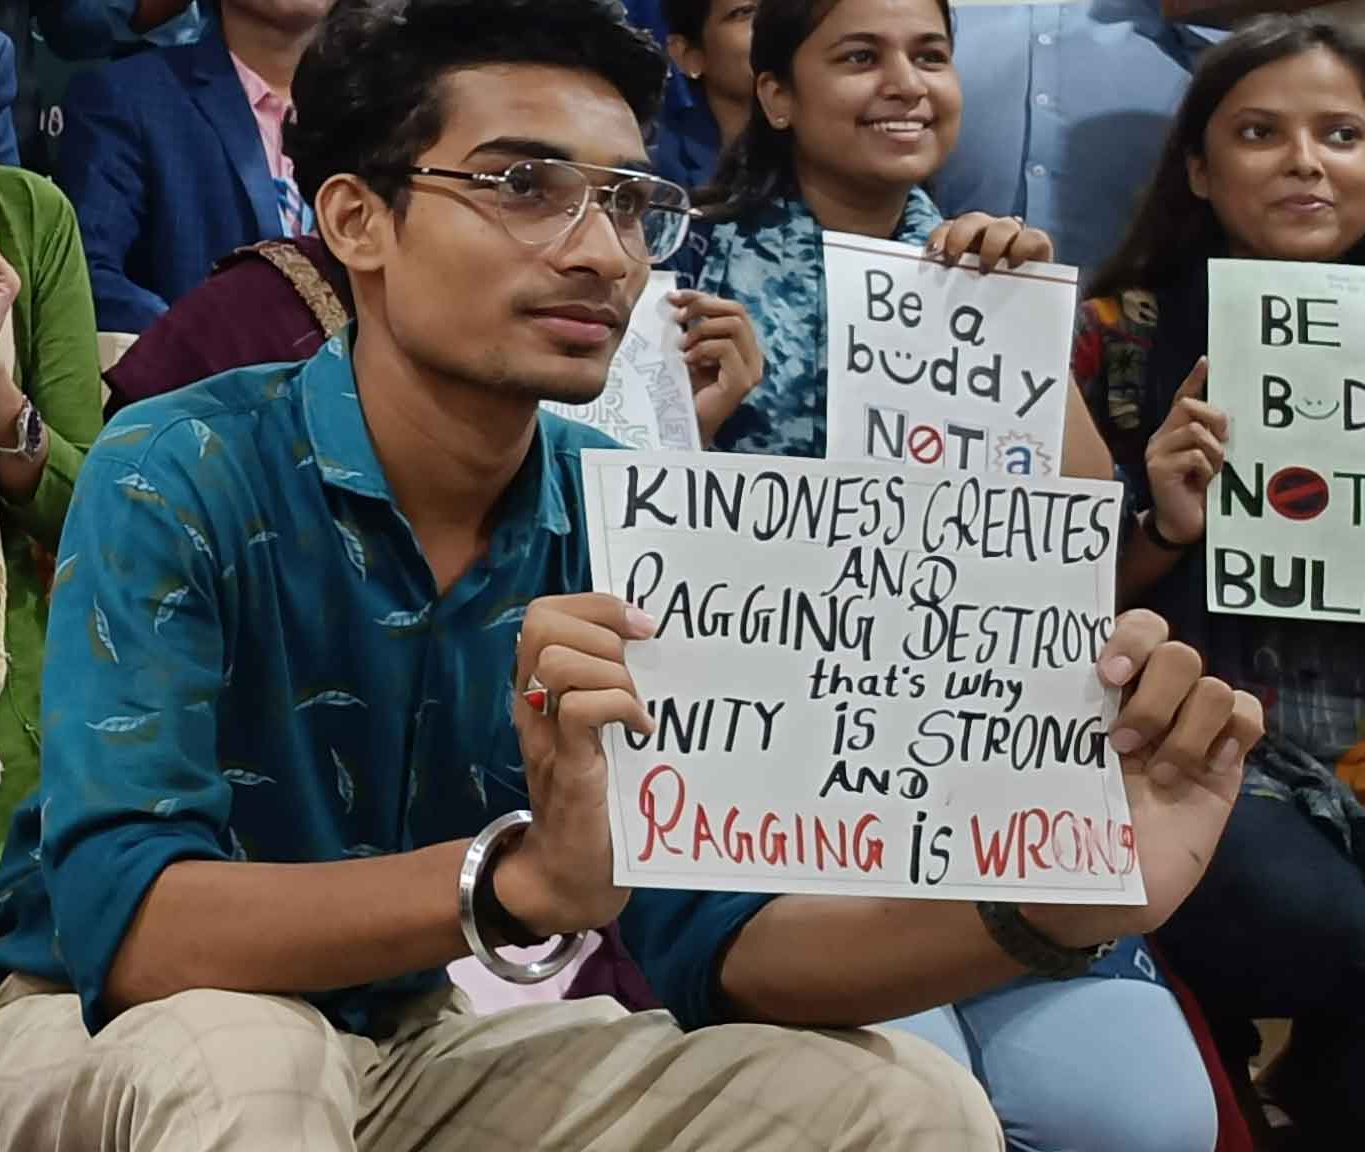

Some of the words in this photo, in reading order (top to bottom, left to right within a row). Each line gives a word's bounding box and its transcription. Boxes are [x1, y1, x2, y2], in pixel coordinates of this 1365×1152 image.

[865, 268, 922, 329] Be
[949, 305, 986, 346] a
[1260, 294, 1341, 348] BE
[867, 408, 985, 470] NOT
[1004, 445, 1032, 476] a
[621, 464, 905, 548] KINDNESS
[921, 475, 1117, 566] CREATES
[625, 551, 875, 661] RAGGING
[821, 545, 958, 607] AND
[808, 657, 927, 699] that's
[908, 709, 1110, 771] STRONG
[819, 760, 930, 801] AND
[637, 763, 885, 873] RAGGING
